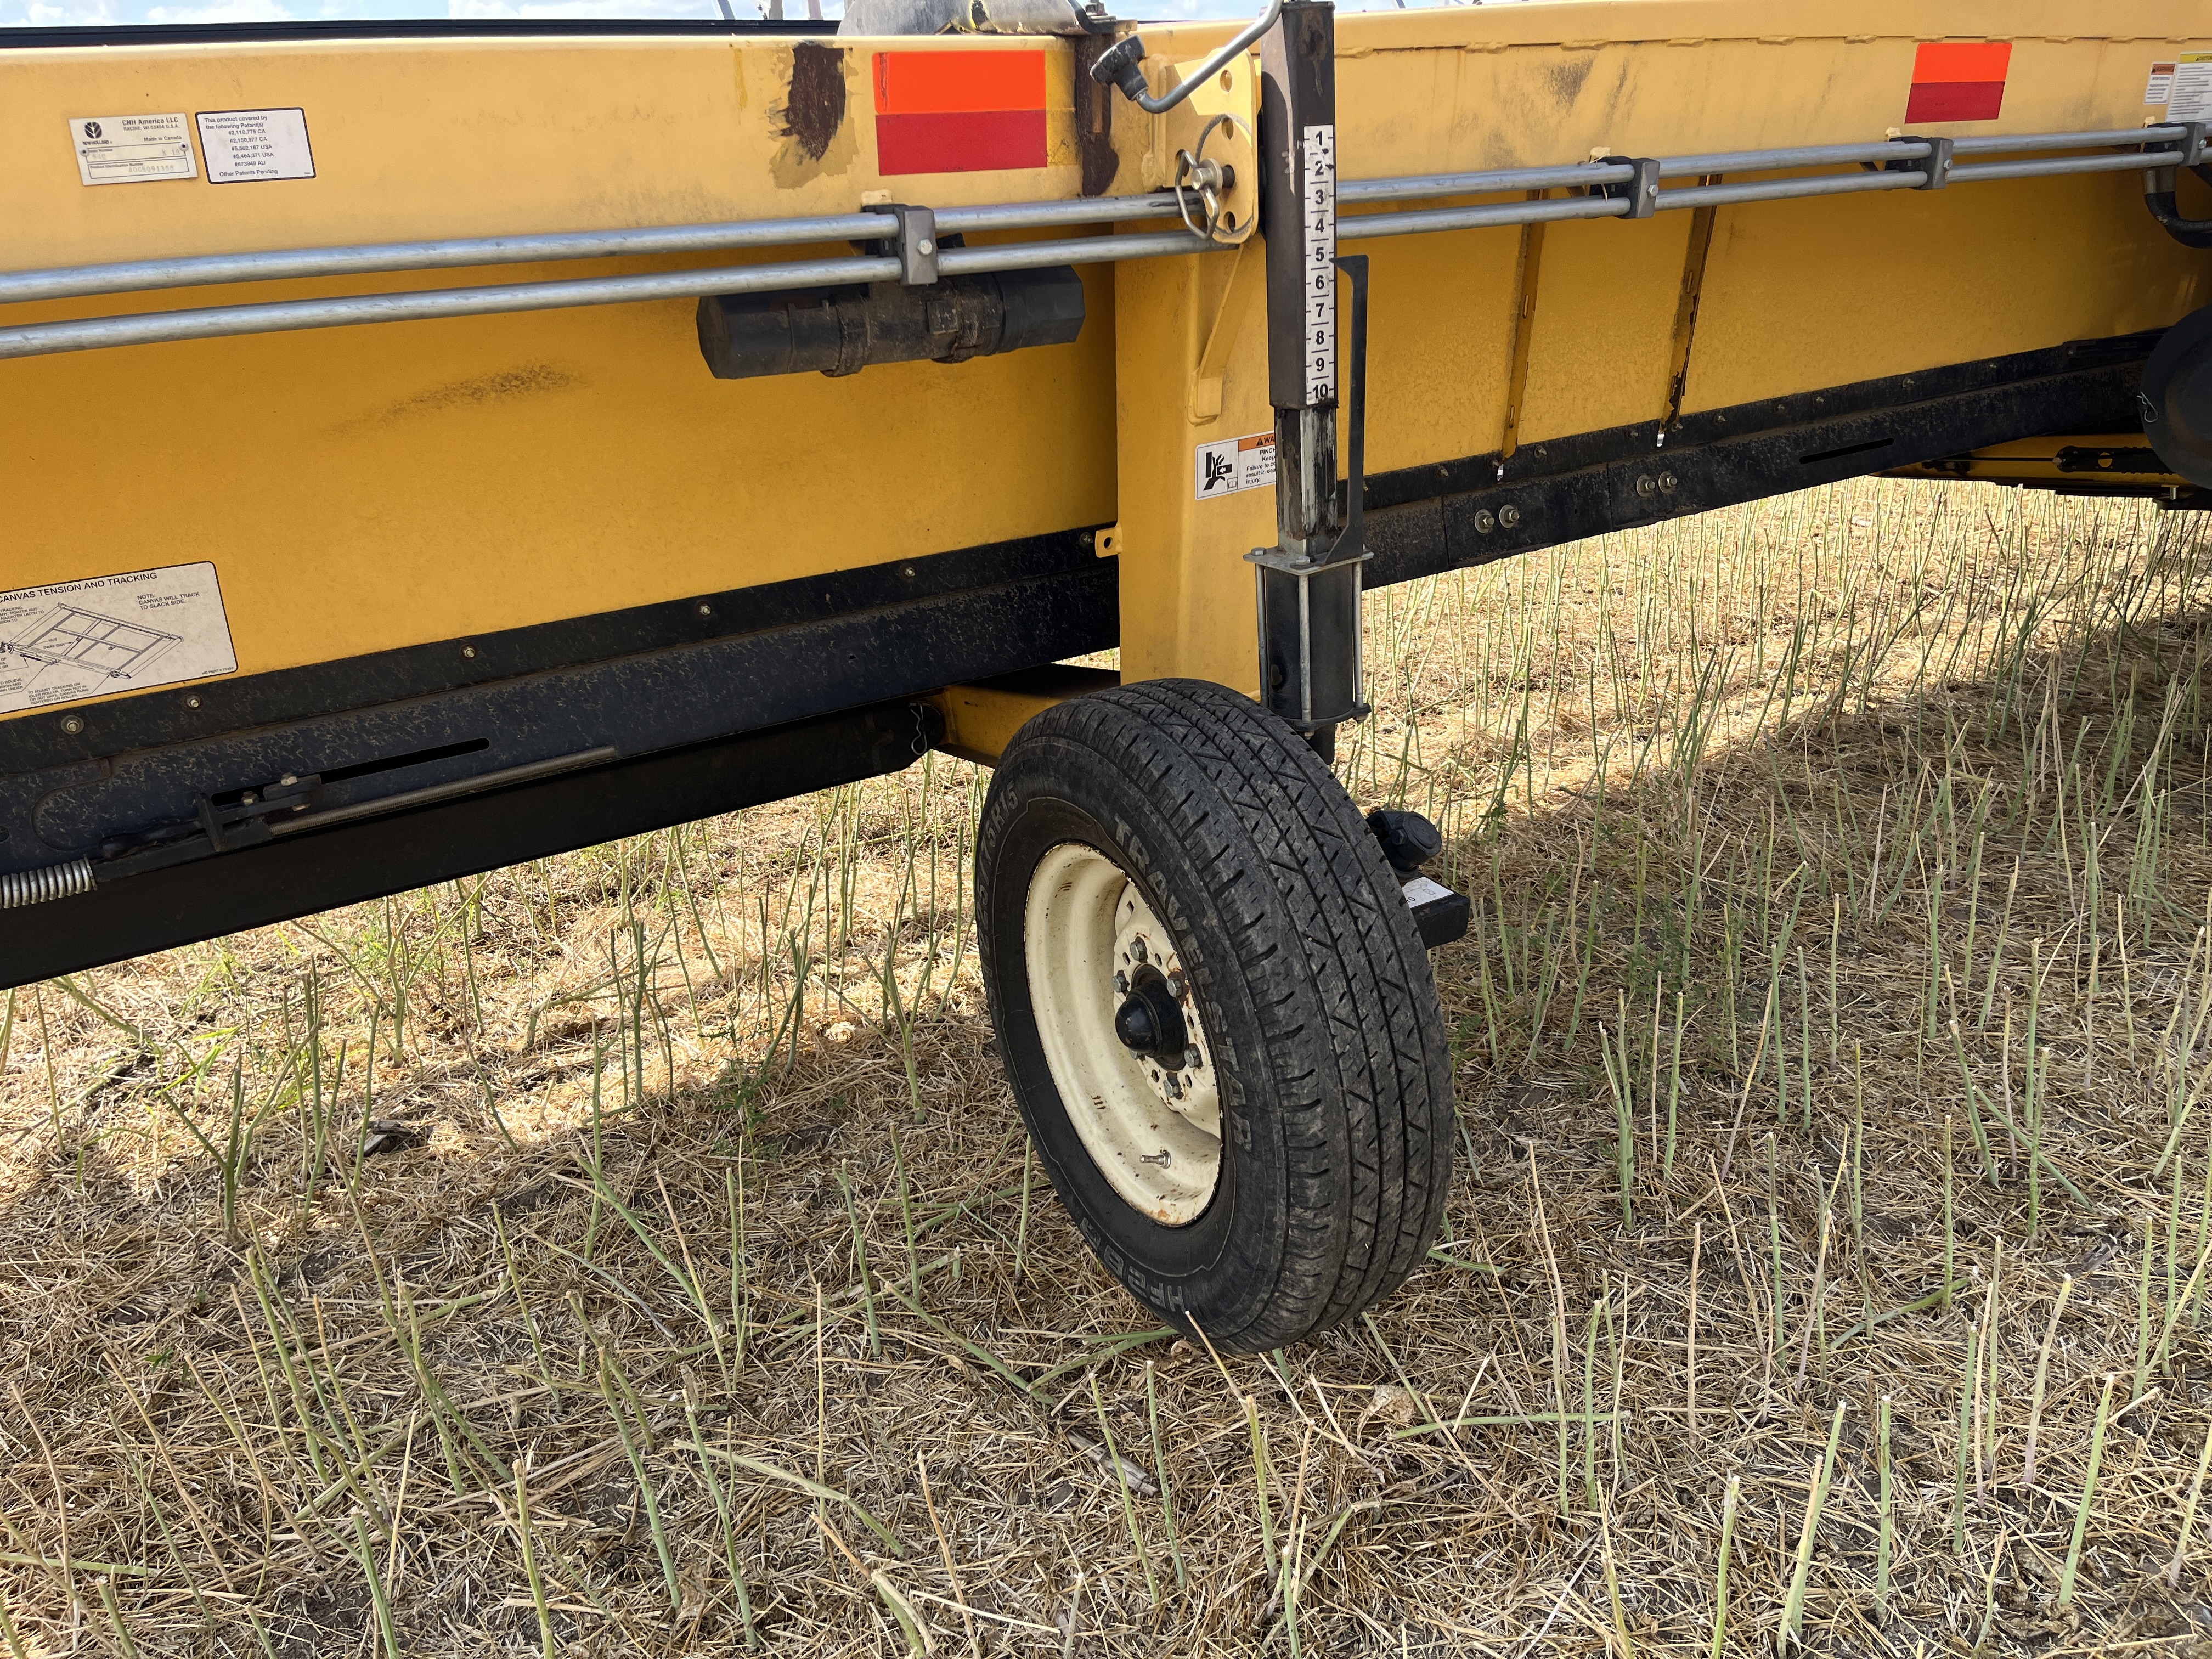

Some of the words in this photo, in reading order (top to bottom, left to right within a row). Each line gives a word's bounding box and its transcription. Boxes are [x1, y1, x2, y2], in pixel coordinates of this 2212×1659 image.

[1316, 131, 1323, 146] 1
[1314, 161, 1324, 176] 2
[1315, 190, 1324, 205] 3
[1315, 218, 1324, 233] 4
[1316, 247, 1324, 262] 5
[1316, 275, 1324, 290] 6
[1316, 303, 1324, 318] 7
[1316, 331, 1324, 345] 8
[1316, 358, 1325, 372] 9
[1313, 385, 1329, 399] 10
[37, 584, 81, 596] TENSION
[84, 580, 105, 589] AND
[106, 572, 158, 586] TRACKING
[138, 597, 163, 605] CANVAS
[1114, 812, 1252, 1152] TRAVELSTAR
